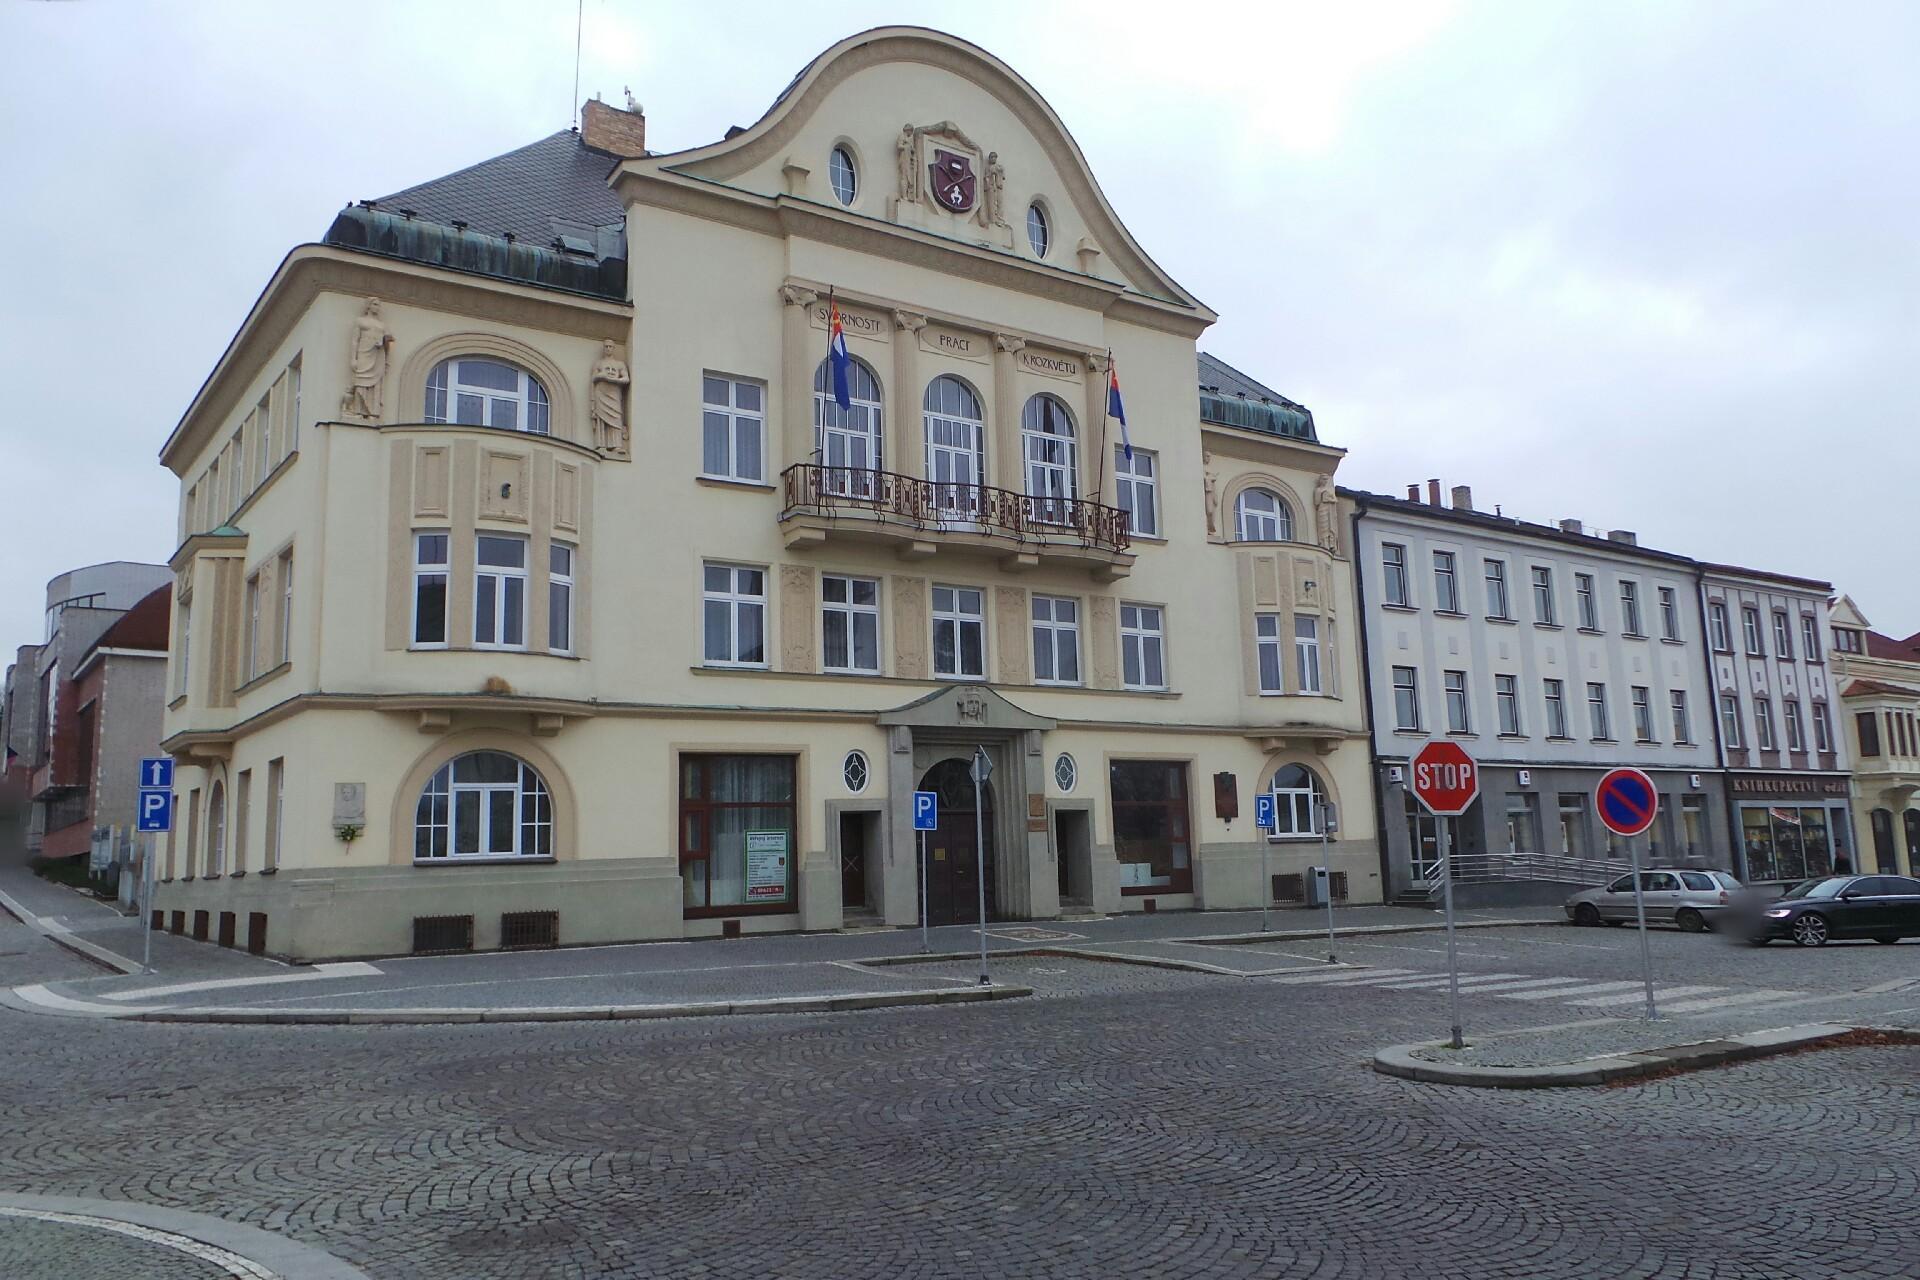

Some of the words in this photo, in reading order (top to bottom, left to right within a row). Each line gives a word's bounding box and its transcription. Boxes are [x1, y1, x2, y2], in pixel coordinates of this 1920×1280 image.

[1023, 353, 1029, 365] K
[1417, 762, 1472, 790] STOP
[145, 794, 165, 818] P
[918, 796, 931, 818] P
[1259, 800, 1269, 817] P
